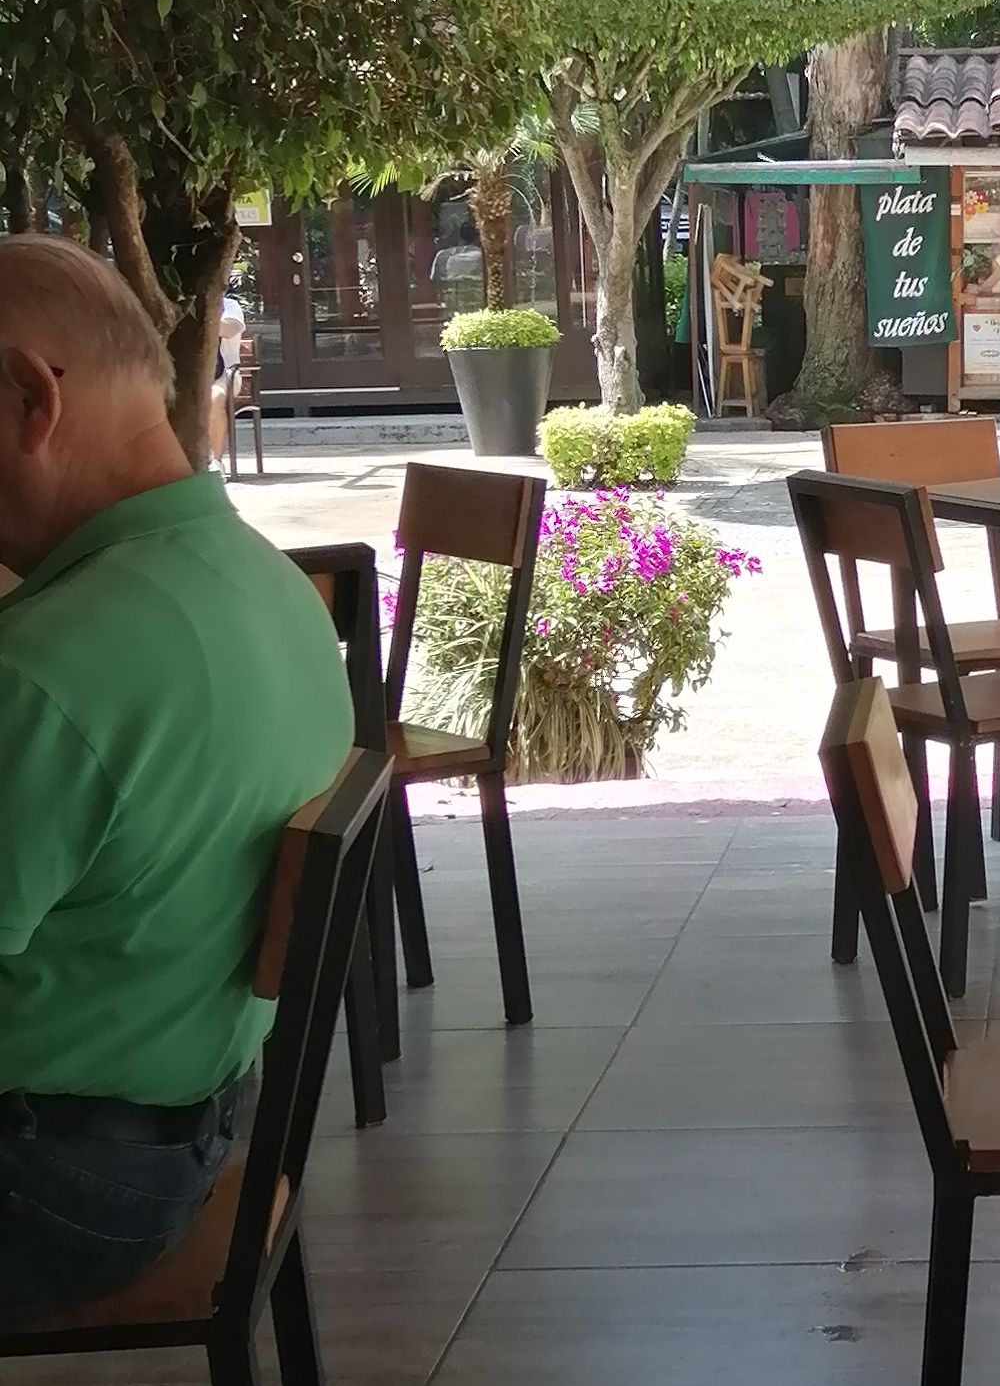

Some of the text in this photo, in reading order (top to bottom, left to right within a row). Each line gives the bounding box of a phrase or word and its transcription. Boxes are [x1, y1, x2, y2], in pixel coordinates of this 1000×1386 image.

[875, 185, 937, 221] plata
[892, 226, 923, 257] de
[893, 271, 929, 299] tus
[873, 310, 949, 338] sueños
